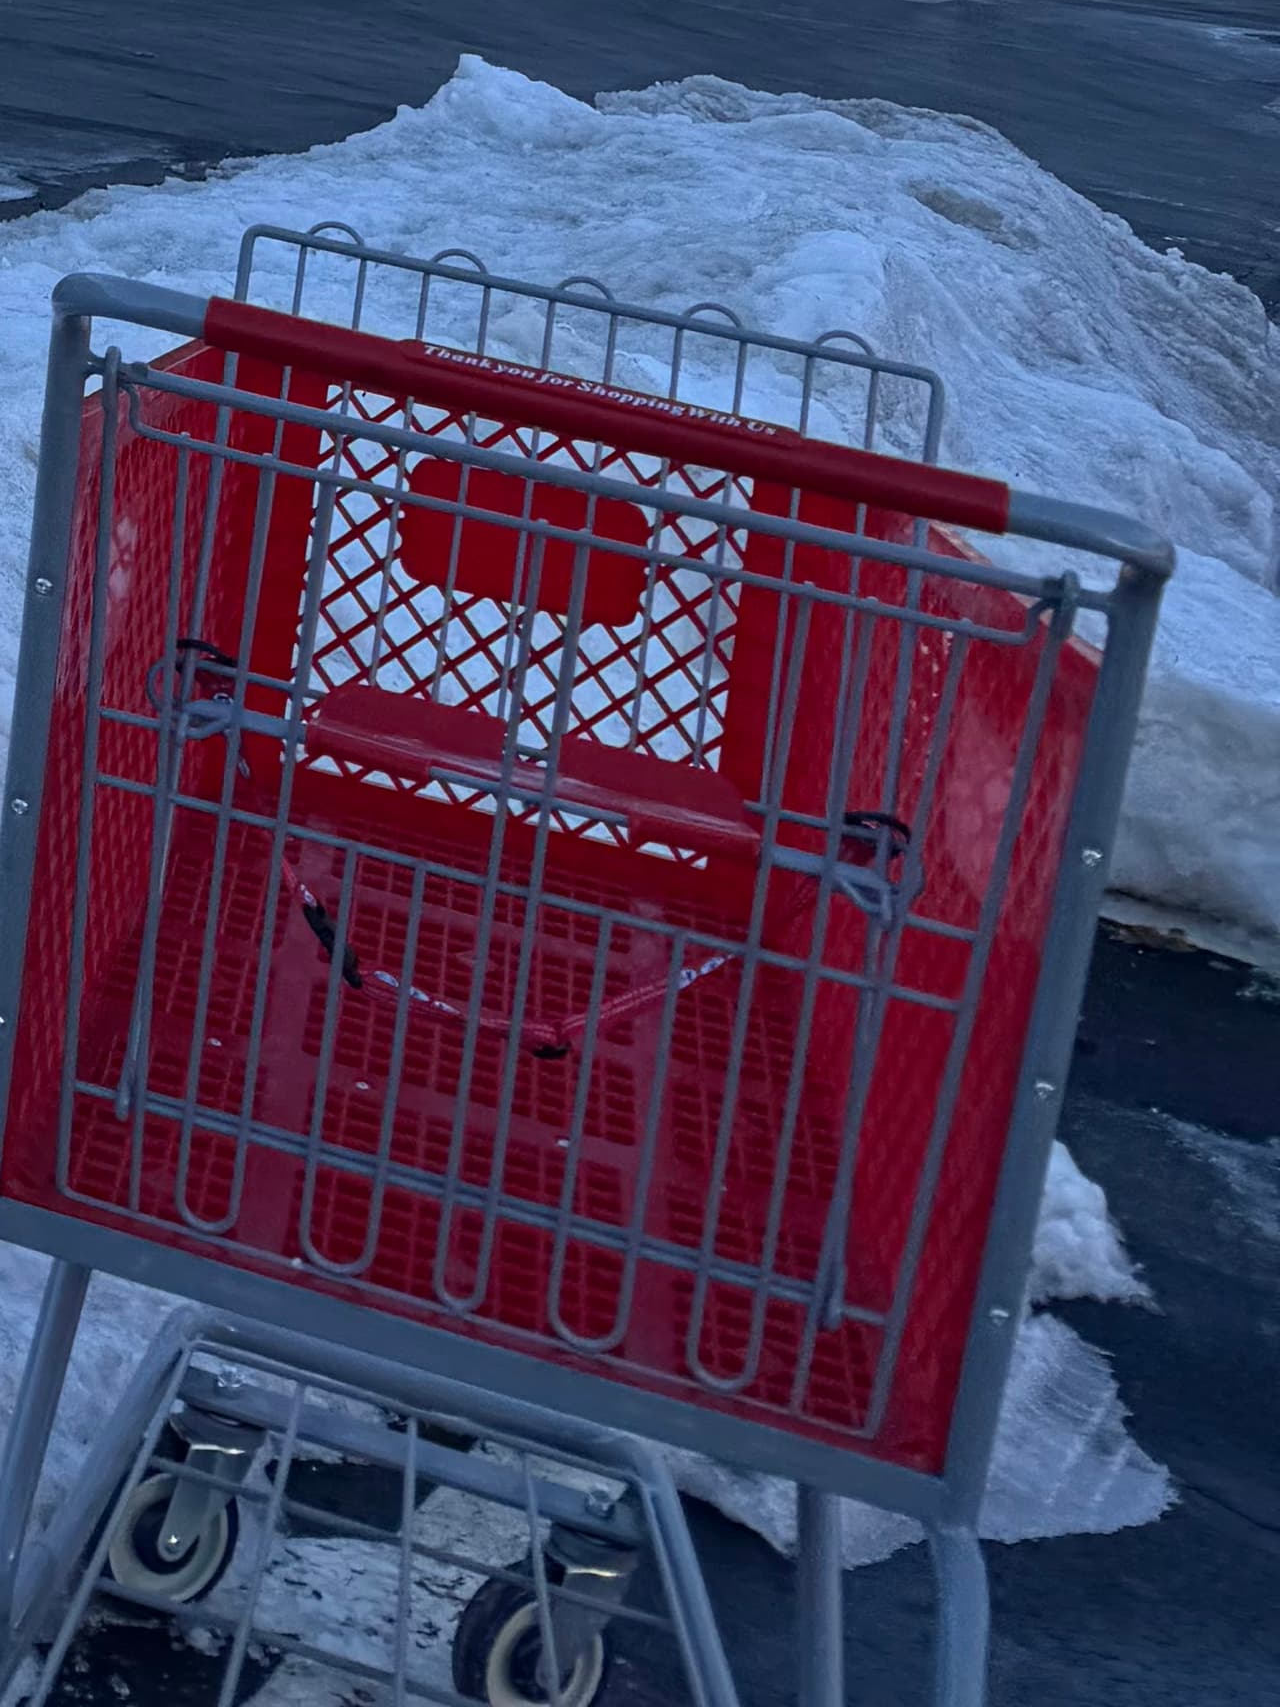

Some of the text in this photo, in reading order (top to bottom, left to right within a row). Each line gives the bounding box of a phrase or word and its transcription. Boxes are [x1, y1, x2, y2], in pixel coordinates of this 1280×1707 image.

[423, 344, 778, 437] Thank you for Shopping With Us
